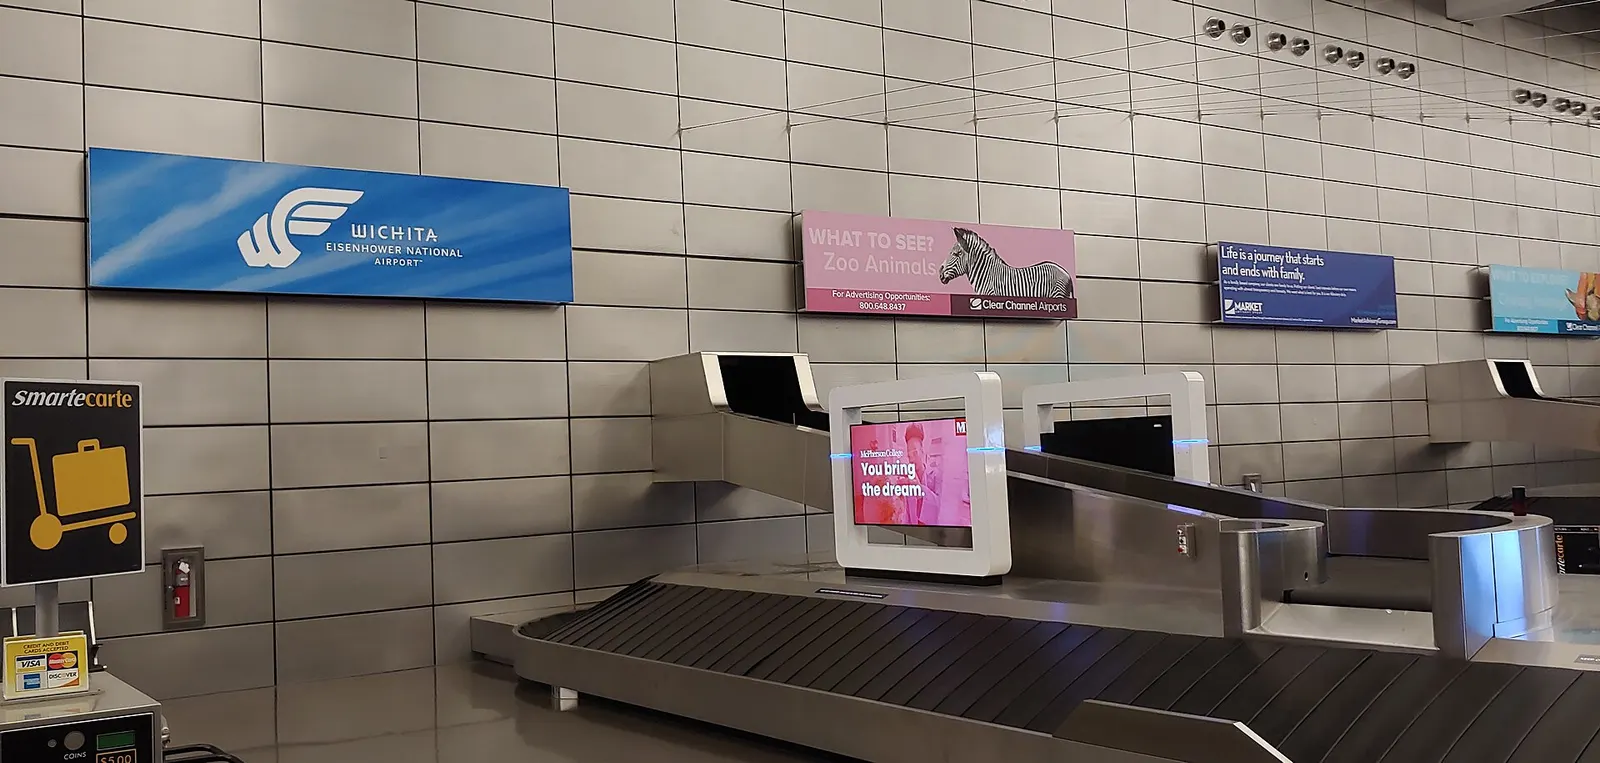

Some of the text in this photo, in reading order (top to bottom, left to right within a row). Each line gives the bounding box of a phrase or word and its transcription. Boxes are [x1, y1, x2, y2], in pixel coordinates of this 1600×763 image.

[351, 223, 438, 242] WICHITA
[808, 227, 934, 252] WHAT TO SEE?
[326, 242, 463, 258] EISENHOWER NATIONAL
[1221, 245, 1325, 266] Life is a journey that starts
[823, 251, 937, 276] Zoo Animals
[1222, 263, 1306, 283] and ends with family.
[832, 289, 931, 302] For Advertising Opportunities:
[859, 301, 906, 311] 800.648.8437
[982, 299, 1067, 313] Clear Channel Airports
[1234, 302, 1263, 312] MARKET
[12, 388, 133, 408] smartecarte
[860, 448, 904, 458] McPherson College
[861, 460, 916, 480] You bring
[862, 481, 925, 497] the dream.
[43, 645, 69, 653] ACCEPTED
[21, 660, 41, 668] VISA
[49, 671, 77, 679] DISCOVER
[63, 751, 87, 761] COINS
